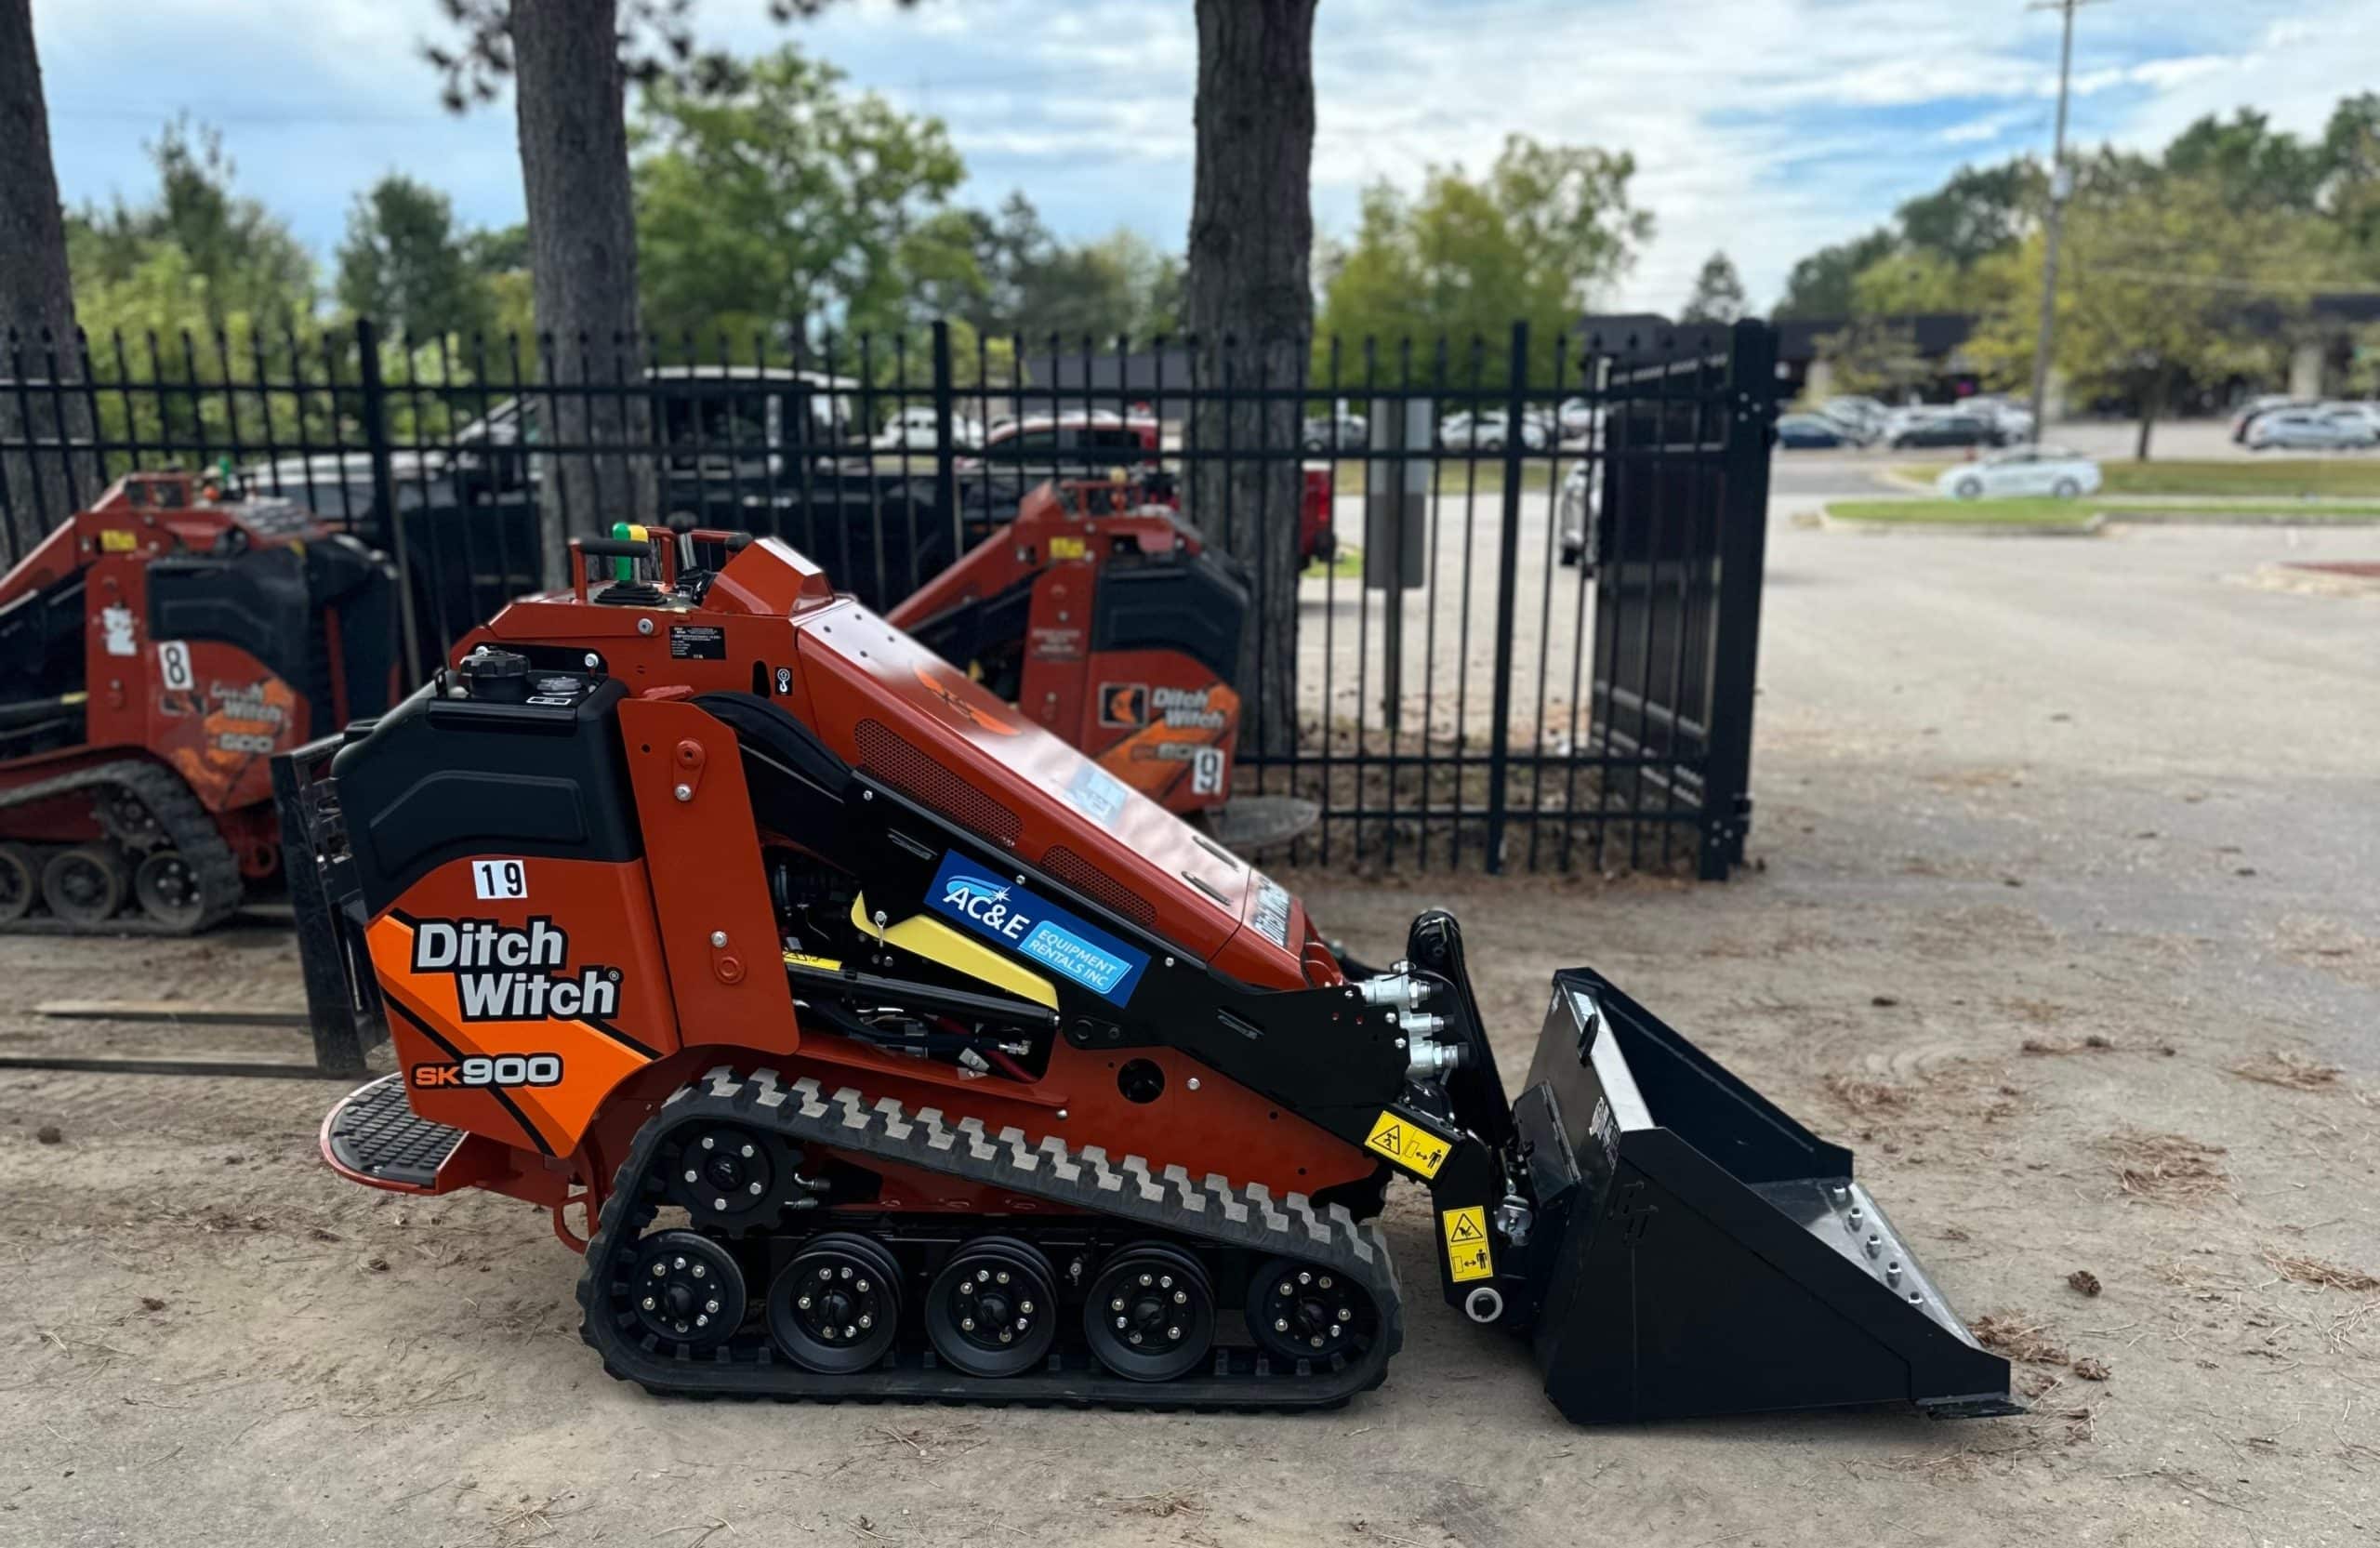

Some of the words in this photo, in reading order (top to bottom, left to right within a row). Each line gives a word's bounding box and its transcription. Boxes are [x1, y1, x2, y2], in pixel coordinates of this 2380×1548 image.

[165, 646, 186, 685] 8
[1153, 688, 1208, 708] Ditch
[1200, 753, 1218, 789] 9
[482, 863, 523, 896] 19
[943, 887, 1031, 939] AC&E
[417, 921, 563, 968] Ditch
[1029, 939, 1083, 974] RENTALS
[1084, 969, 1109, 987] INC
[1038, 930, 1117, 975] EQUIPMENT
[416, 1056, 560, 1086] SK900
